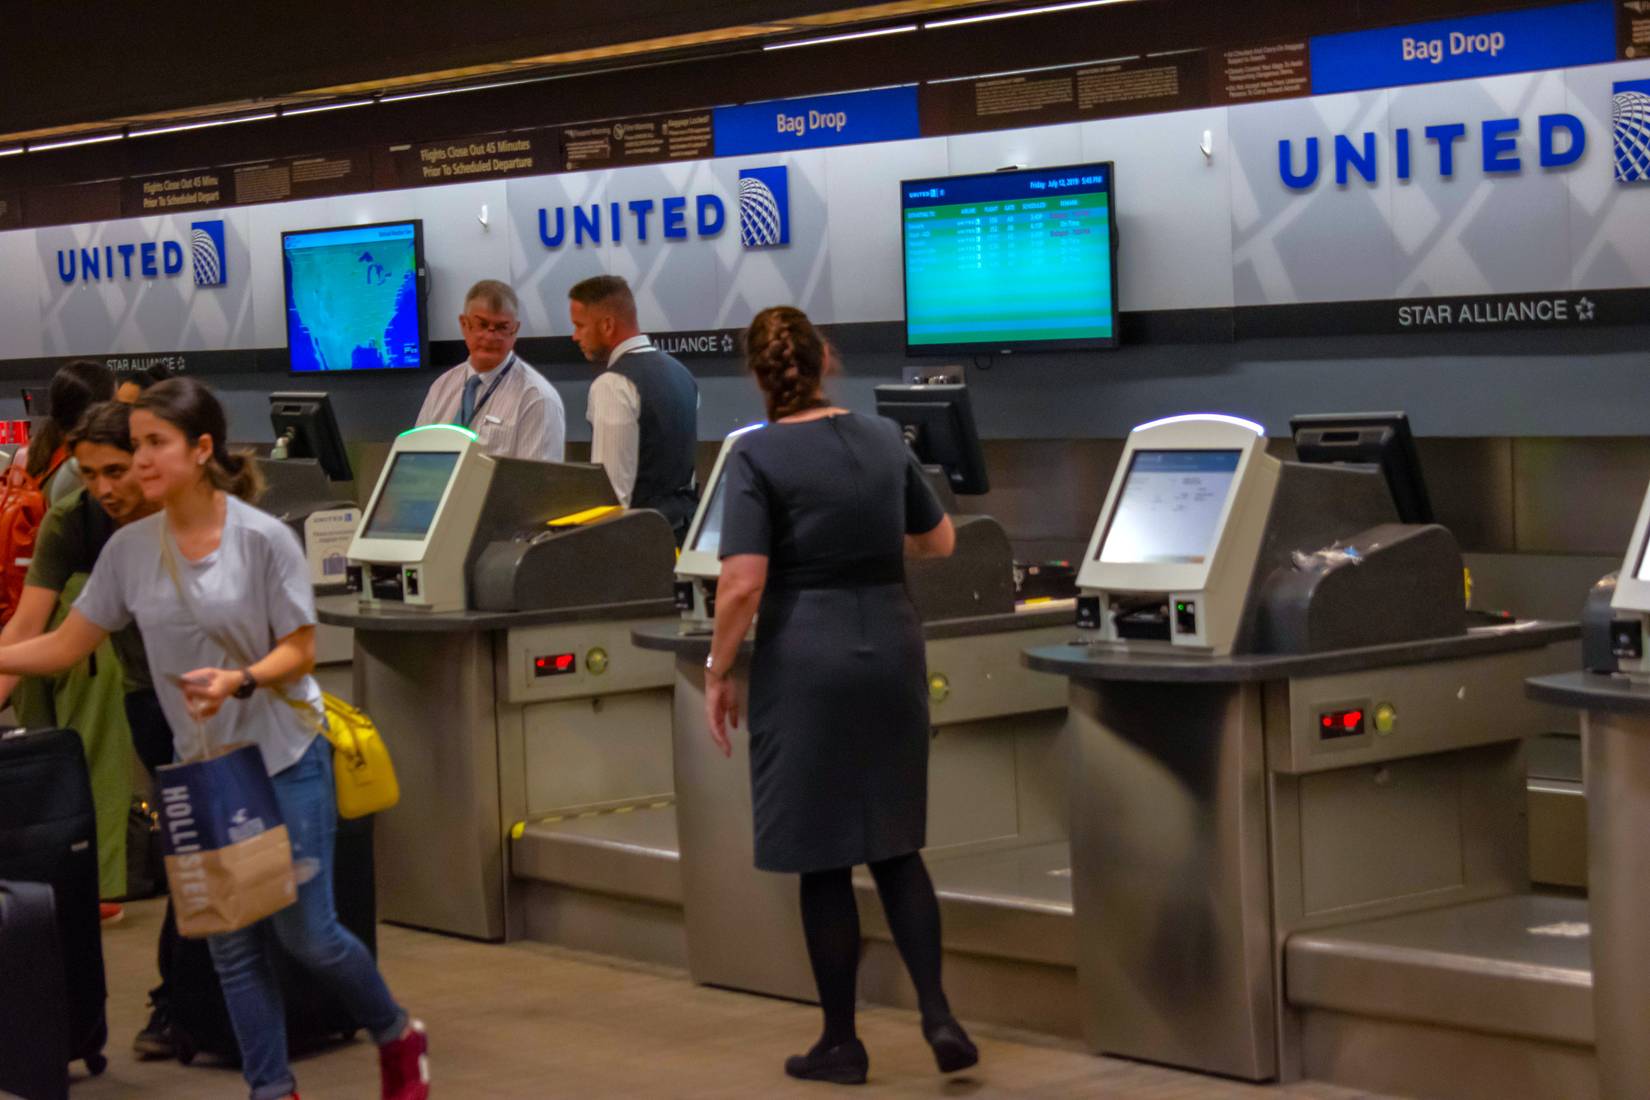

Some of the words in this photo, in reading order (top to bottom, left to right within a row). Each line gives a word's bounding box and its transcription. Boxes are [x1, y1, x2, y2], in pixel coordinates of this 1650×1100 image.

[1402, 36, 1443, 65] Bag
[1449, 31, 1505, 58] Drop
[776, 112, 805, 136] Bag
[808, 110, 847, 133] Drop
[420, 148, 445, 163] Flights
[447, 146, 469, 158] Close
[469, 144, 486, 154] Out
[486, 142, 496, 153] 45
[497, 140, 531, 152] Minutes
[1278, 114, 1586, 190] UNITED
[422, 166, 441, 177] Prior
[442, 164, 451, 175] To
[453, 159, 492, 174] Scheduled
[493, 157, 533, 172] Departure
[537, 194, 726, 248] UNITED
[57, 241, 183, 283] UNITED
[1398, 305, 1452, 325] STAR
[1458, 299, 1568, 324] ALLIANCE
[653, 336, 718, 353] ALLIANCE
[106, 358, 129, 371] STAR
[161, 785, 209, 911] HOLLISTER
